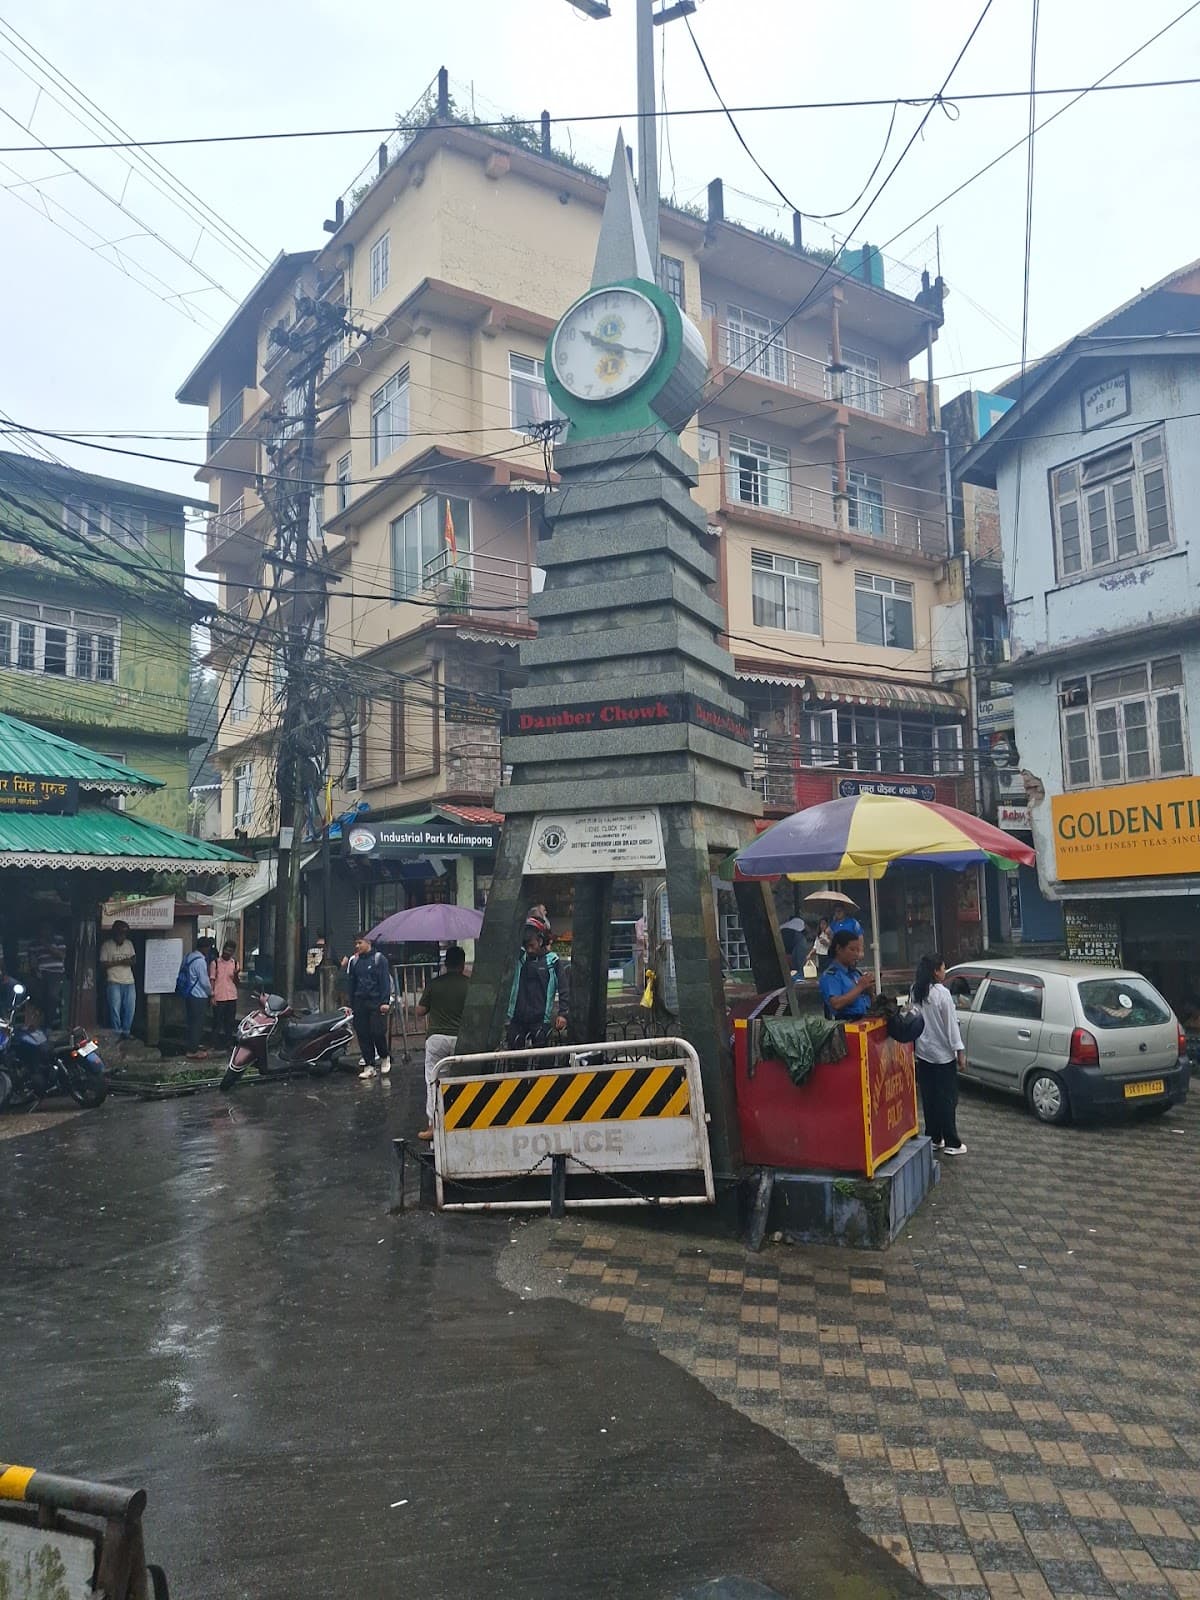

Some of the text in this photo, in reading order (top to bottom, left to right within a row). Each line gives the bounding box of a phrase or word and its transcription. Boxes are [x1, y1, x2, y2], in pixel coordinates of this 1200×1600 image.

[518, 711, 595, 730] Damber
[600, 702, 669, 722] Chowk
[13, 775, 36, 793] सिंह
[1058, 803, 1164, 840] GOLDEN
[1167, 799, 1200, 830] TI
[380, 831, 493, 848] Industrial Park Kalimpong
[1060, 843, 1101, 854] WORLD'S
[1104, 840, 1137, 851] FINEST
[1143, 838, 1168, 848] TEAS
[1069, 948, 1116, 956] FLUSH
[511, 1128, 624, 1158] POLICE
